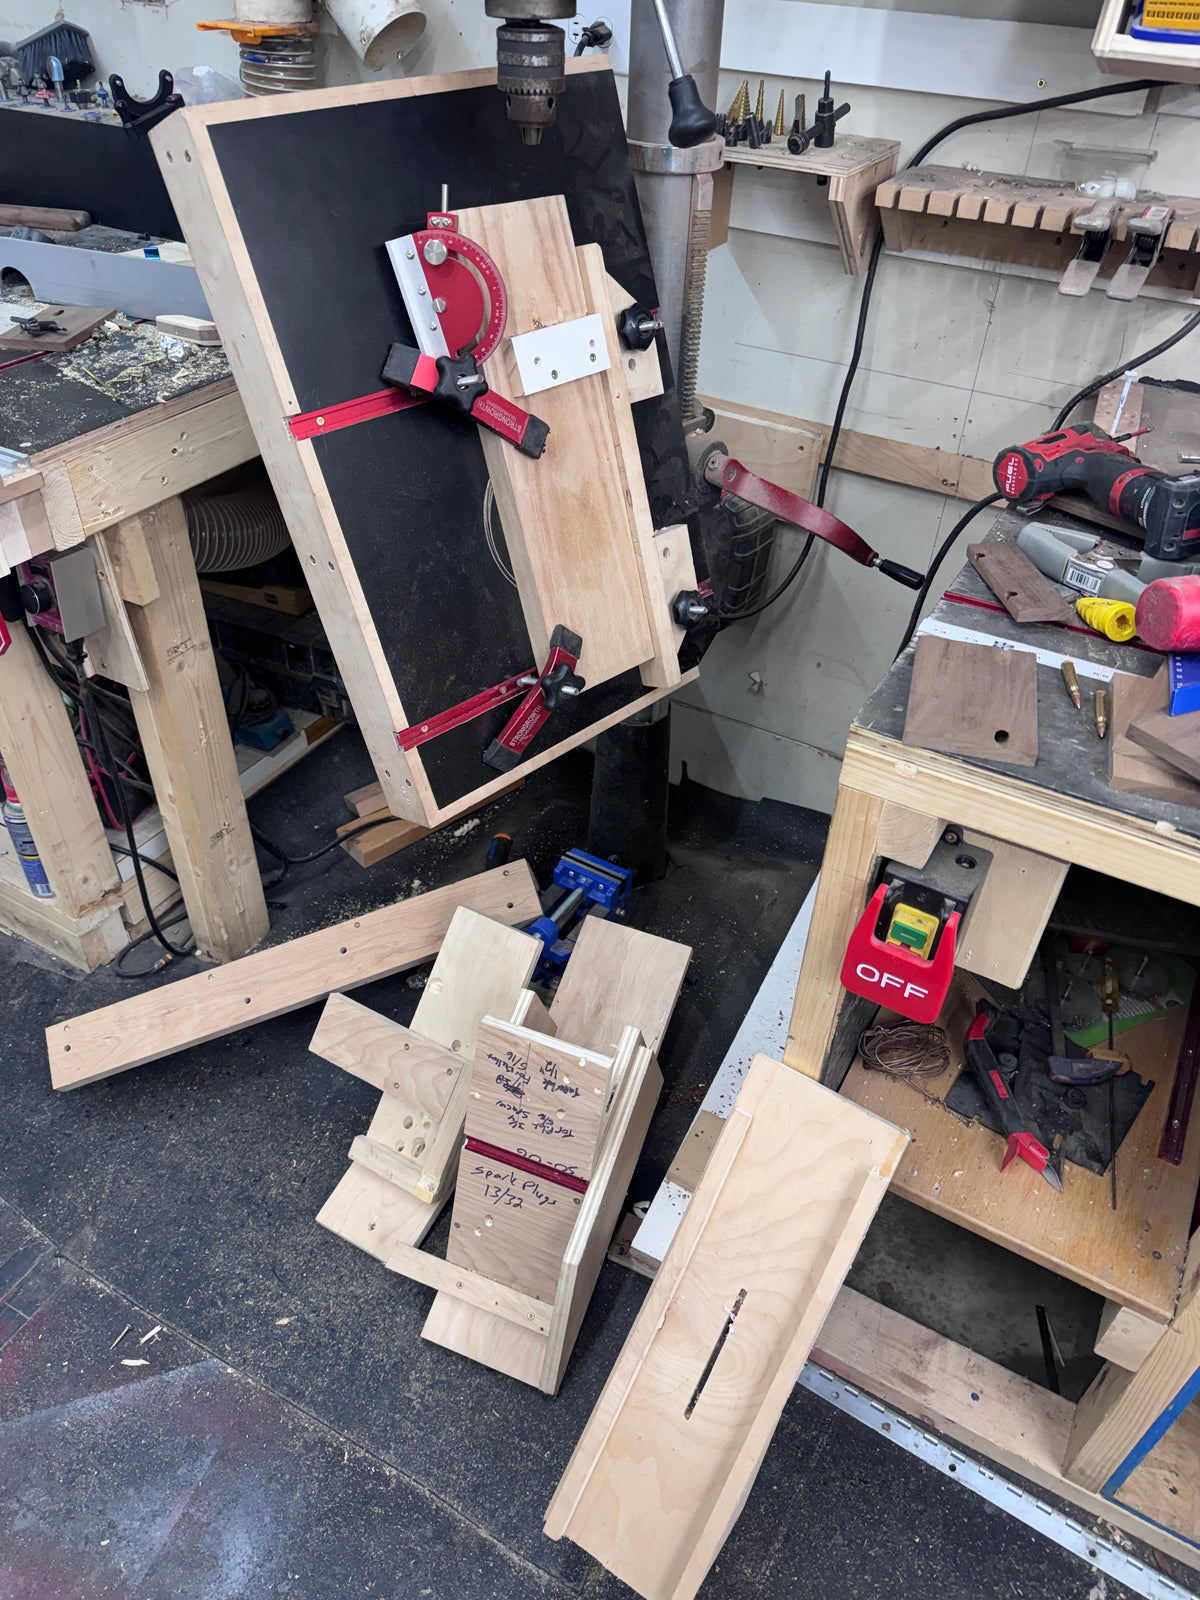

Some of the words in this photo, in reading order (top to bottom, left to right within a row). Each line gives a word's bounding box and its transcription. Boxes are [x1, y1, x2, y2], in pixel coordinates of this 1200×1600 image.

[1005, 457, 1015, 493] FUEL
[856, 963, 929, 999] OFF
[485, 1184, 523, 1209] 13/32
